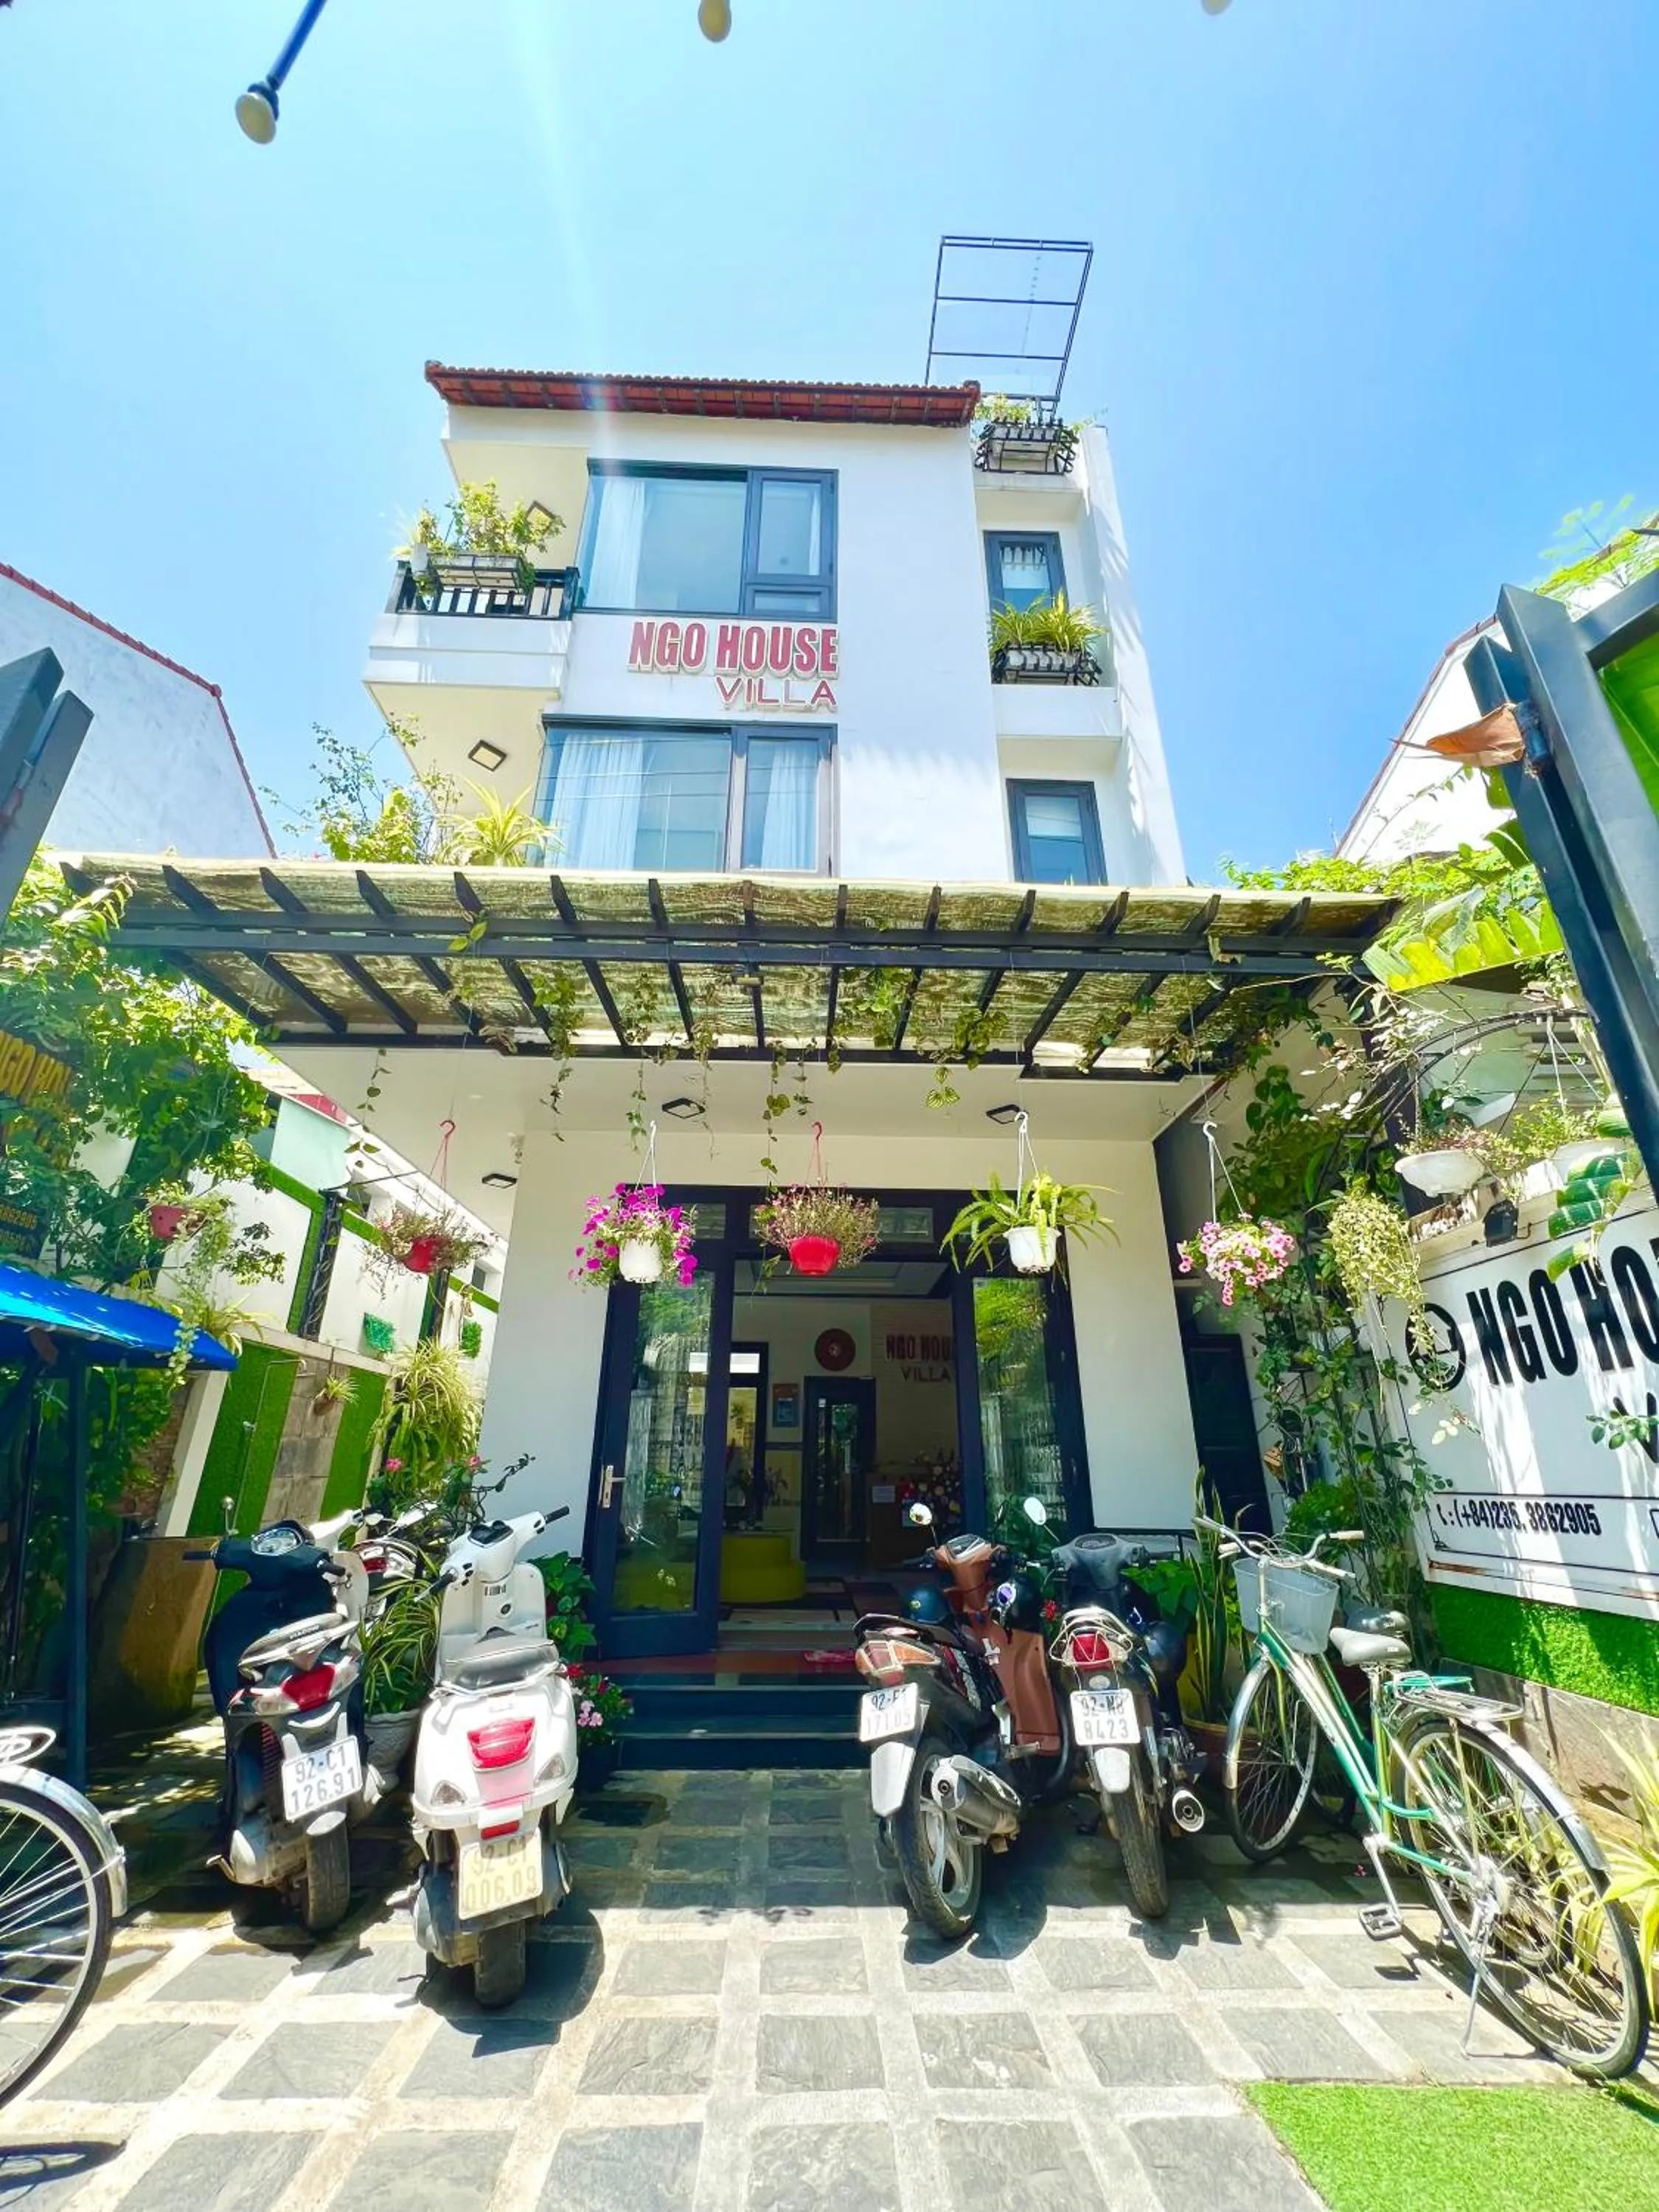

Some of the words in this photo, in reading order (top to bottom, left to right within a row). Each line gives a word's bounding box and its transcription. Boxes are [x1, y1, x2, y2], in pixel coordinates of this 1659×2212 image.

[628, 621, 708, 669] NGO
[715, 624, 838, 676] HOUSE
[714, 676, 837, 711] VILLA
[1466, 1269, 1578, 1386] NGO
[1568, 1237, 1659, 1372] HO
[886, 1334, 916, 1361] NGO
[900, 1364, 951, 1384] VILLA
[1084, 1719, 1129, 1739] 8423
[291, 1767, 355, 1812] 126.91
